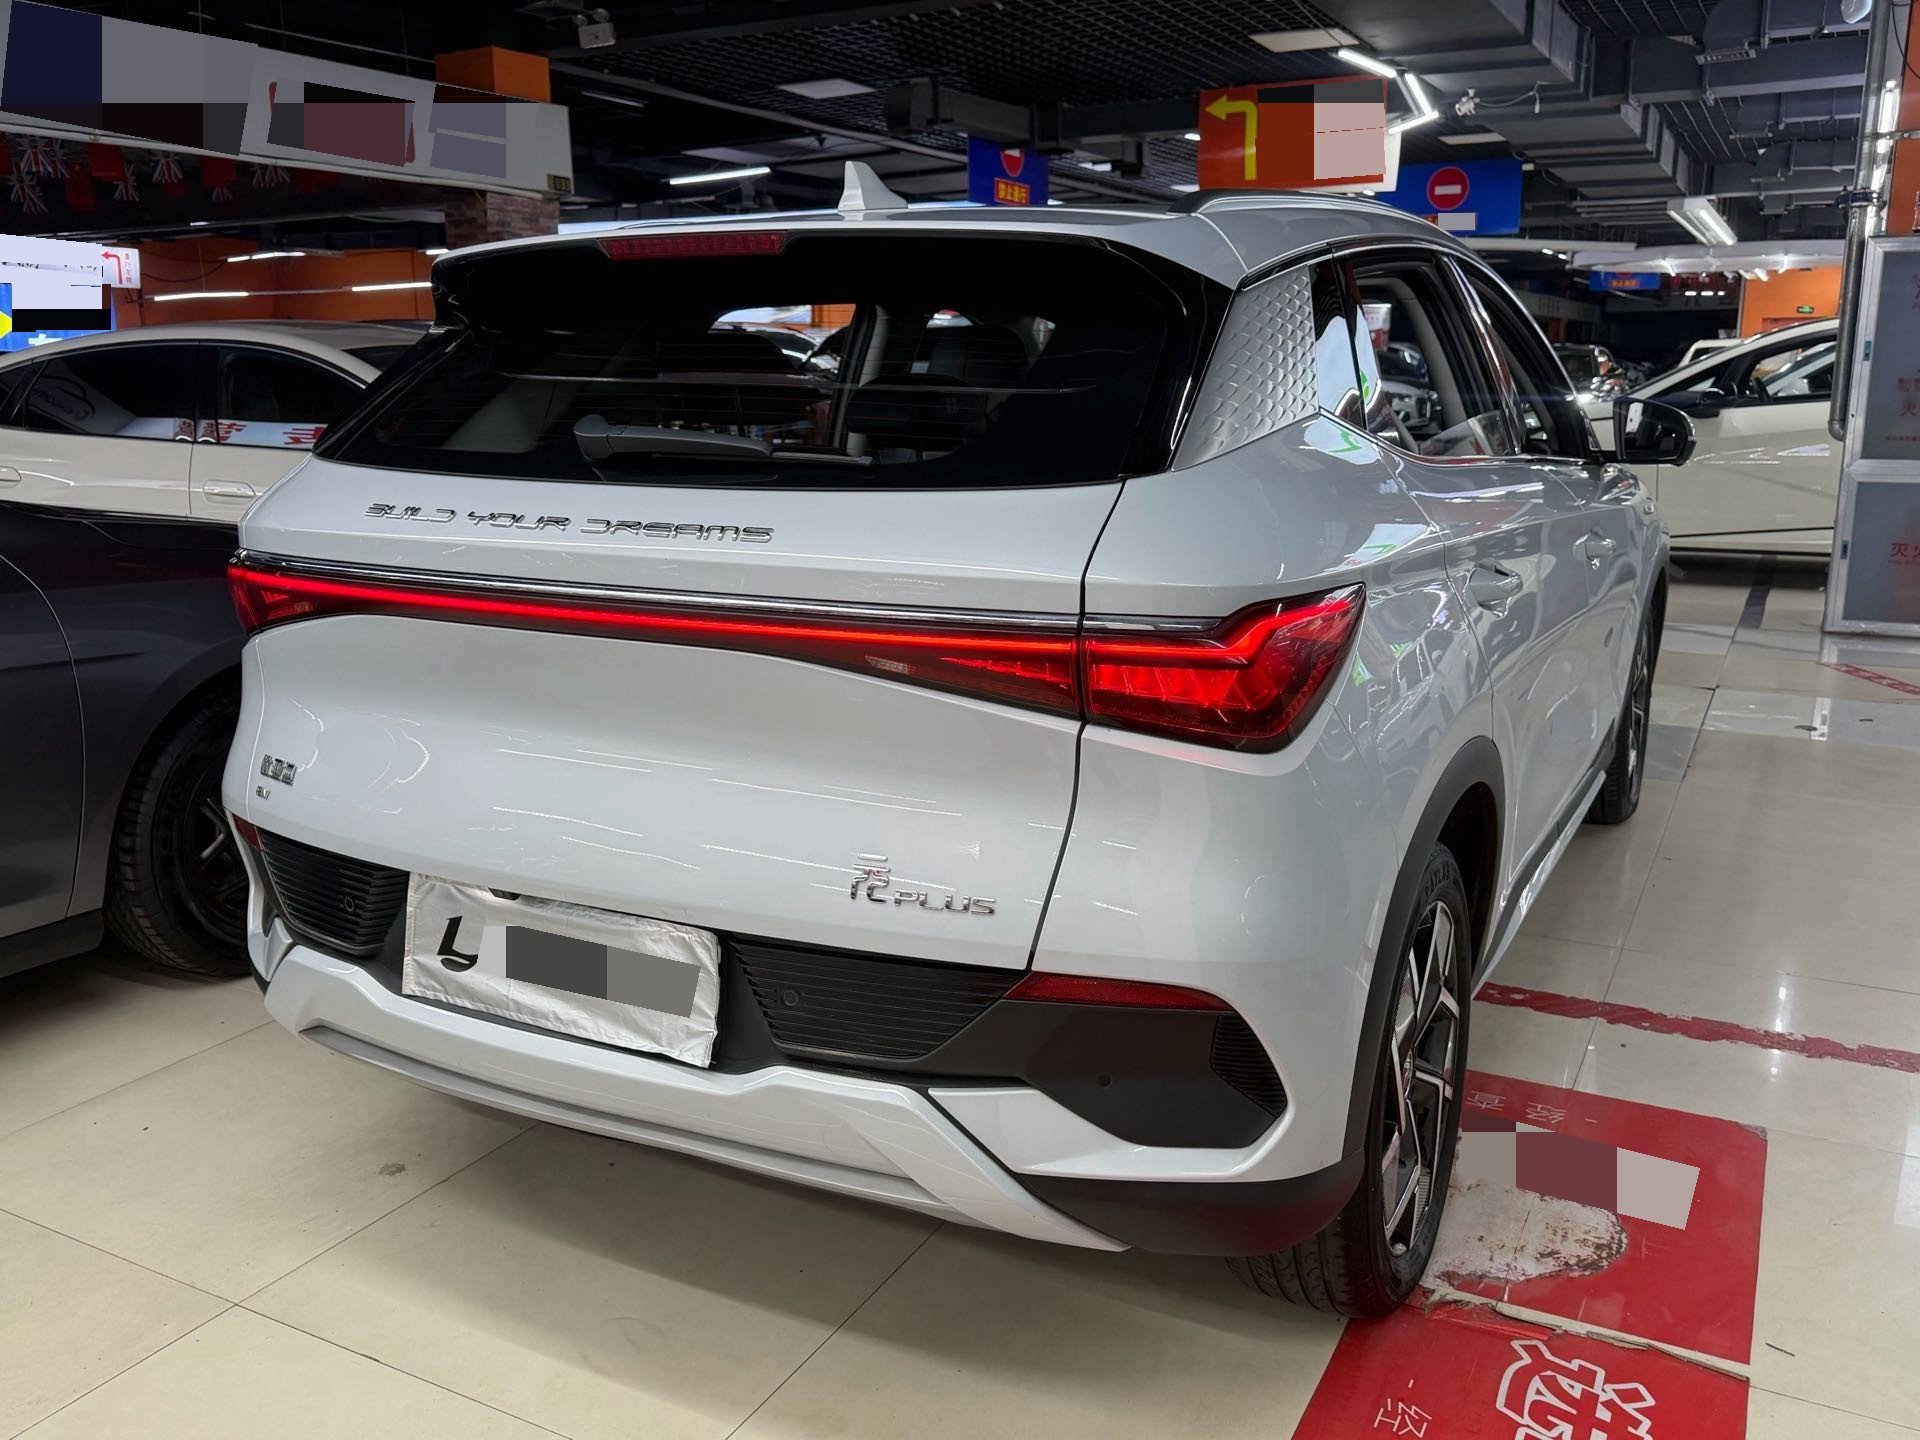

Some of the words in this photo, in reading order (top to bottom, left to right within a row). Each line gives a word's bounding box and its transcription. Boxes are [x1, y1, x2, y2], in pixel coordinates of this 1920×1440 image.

[364, 502, 457, 523] BUILD
[467, 511, 571, 532] YOUR
[580, 518, 774, 544] DREAMS
[894, 888, 997, 915] PLUS
